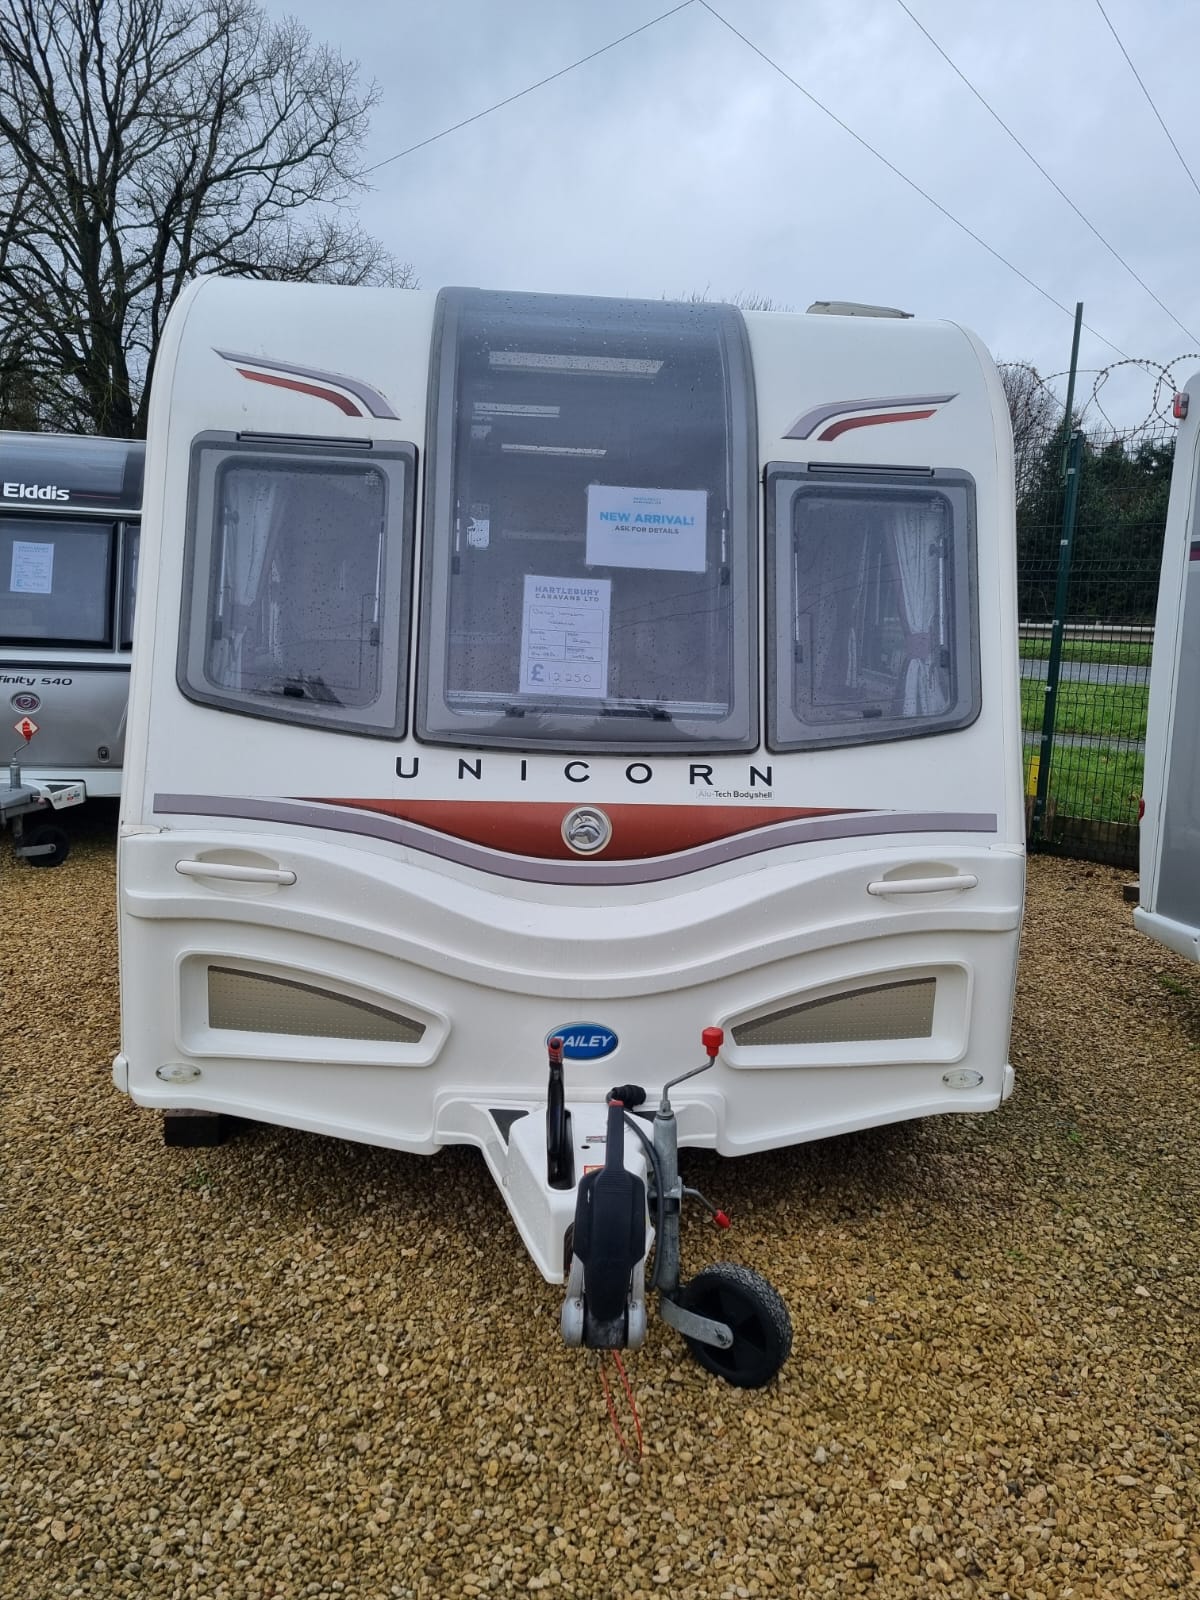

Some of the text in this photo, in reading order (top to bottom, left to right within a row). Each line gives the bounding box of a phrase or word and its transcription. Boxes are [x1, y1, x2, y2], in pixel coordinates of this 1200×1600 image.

[3, 482, 70, 501] Elddis
[599, 511, 695, 526] NEW ARRIVAL!
[649, 527, 679, 535] DETAILS
[535, 585, 600, 596] HARTLEBURY
[535, 593, 581, 601] CARAVANS
[395, 756, 773, 787] UNICORN
[698, 790, 773, 799] Alu-Tech Bodyshell
[553, 1035, 613, 1048] AILEY
